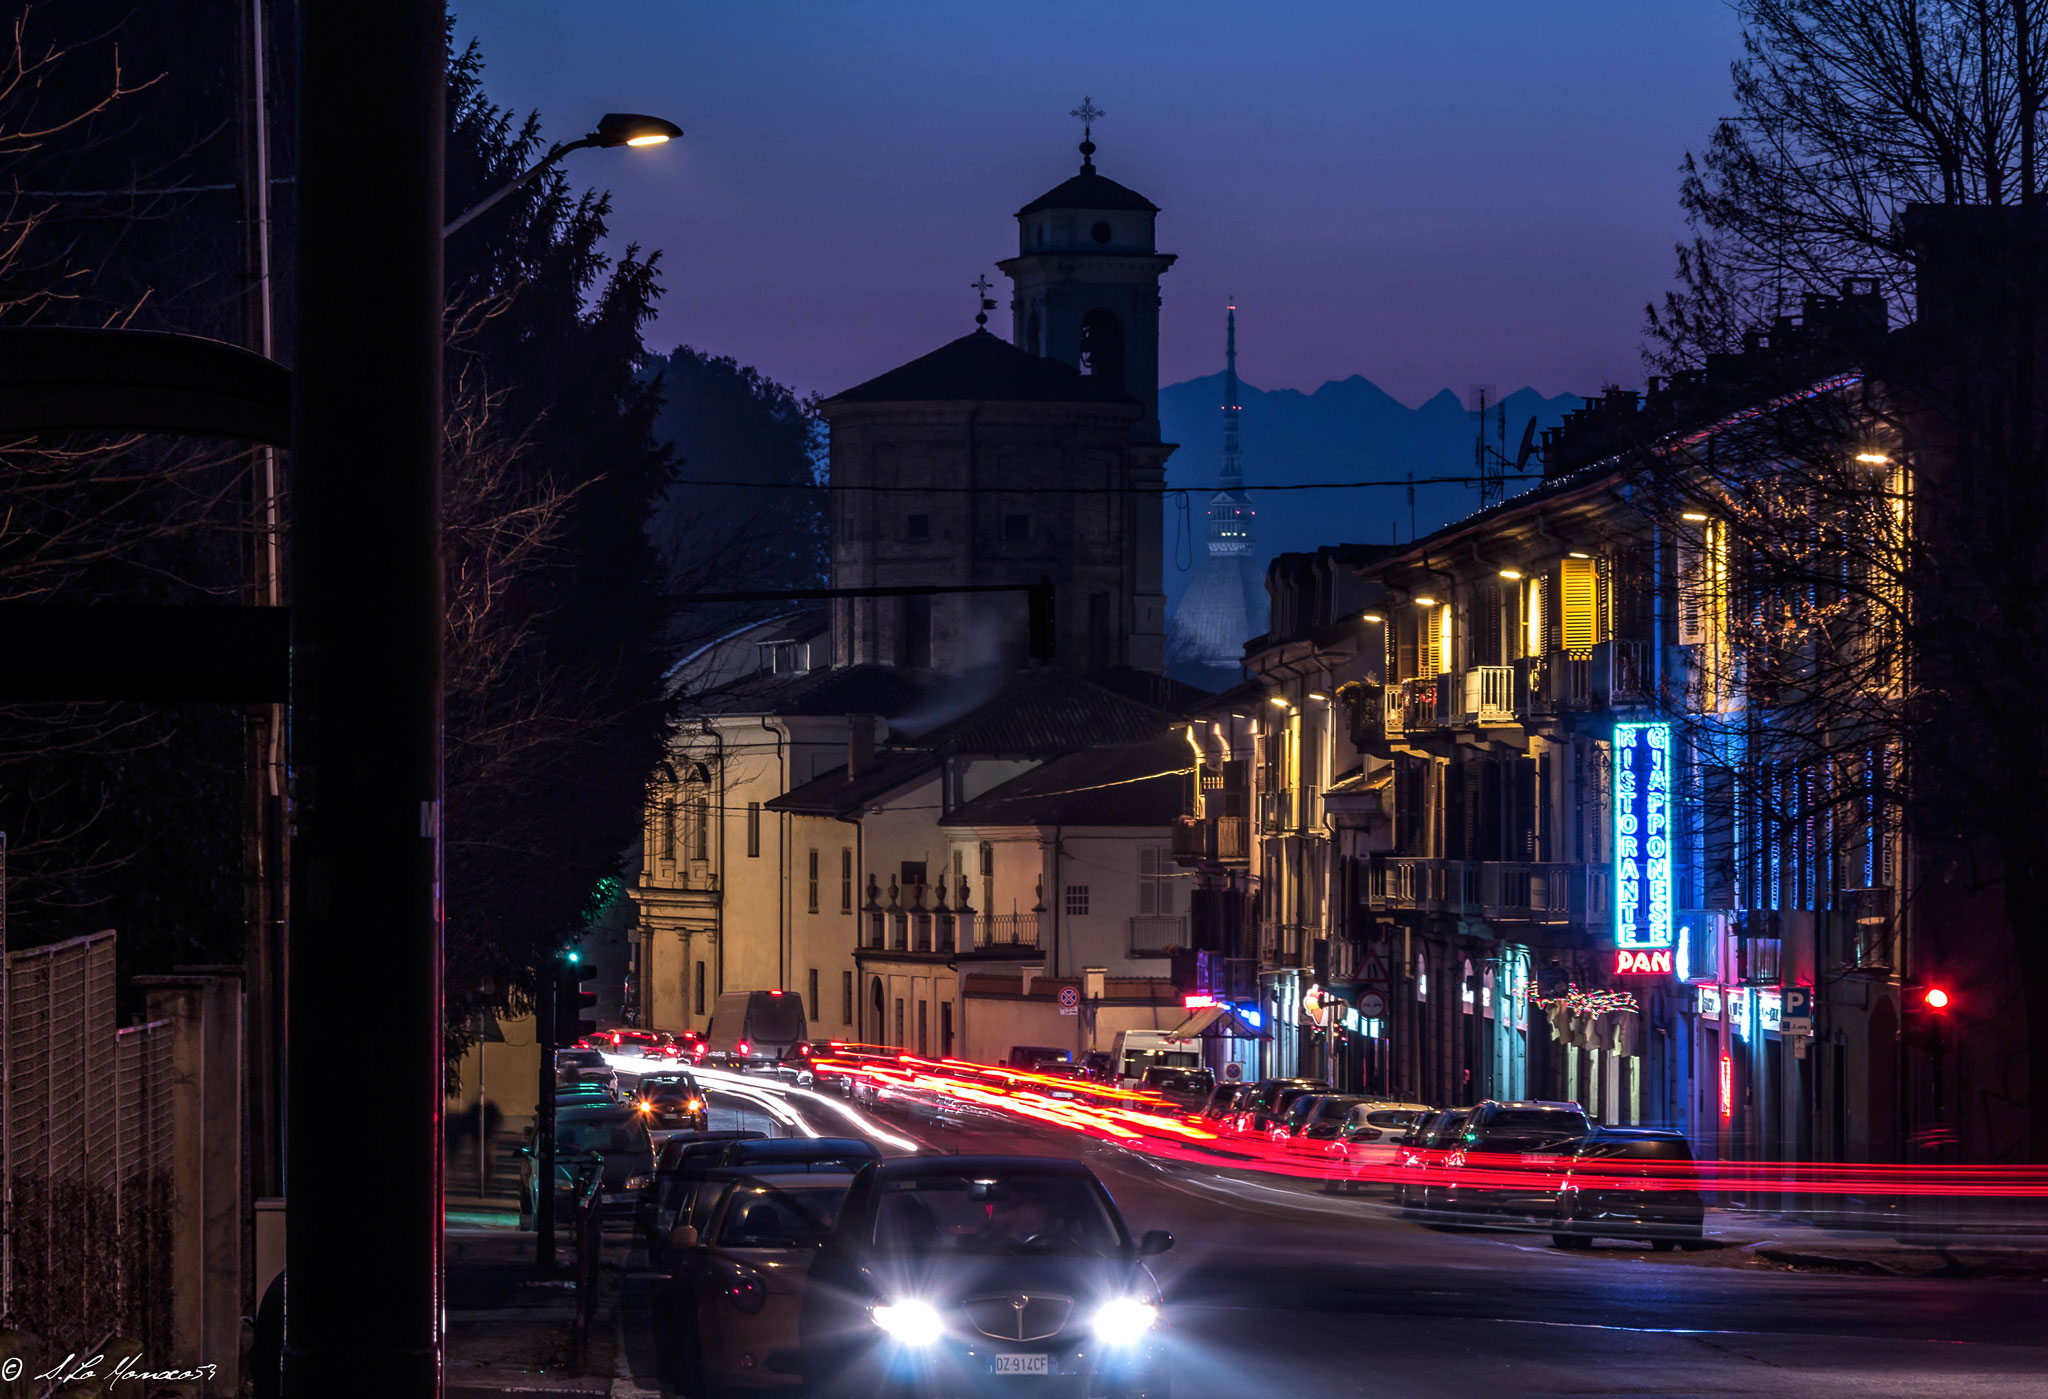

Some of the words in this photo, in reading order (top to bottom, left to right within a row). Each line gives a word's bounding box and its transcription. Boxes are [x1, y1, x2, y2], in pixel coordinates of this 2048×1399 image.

[1620, 727, 1639, 944] RISTORANTE
[1647, 727, 1667, 944] GIAPPONESE
[1617, 951, 1671, 974] PAN
[1786, 991, 1804, 1014] P
